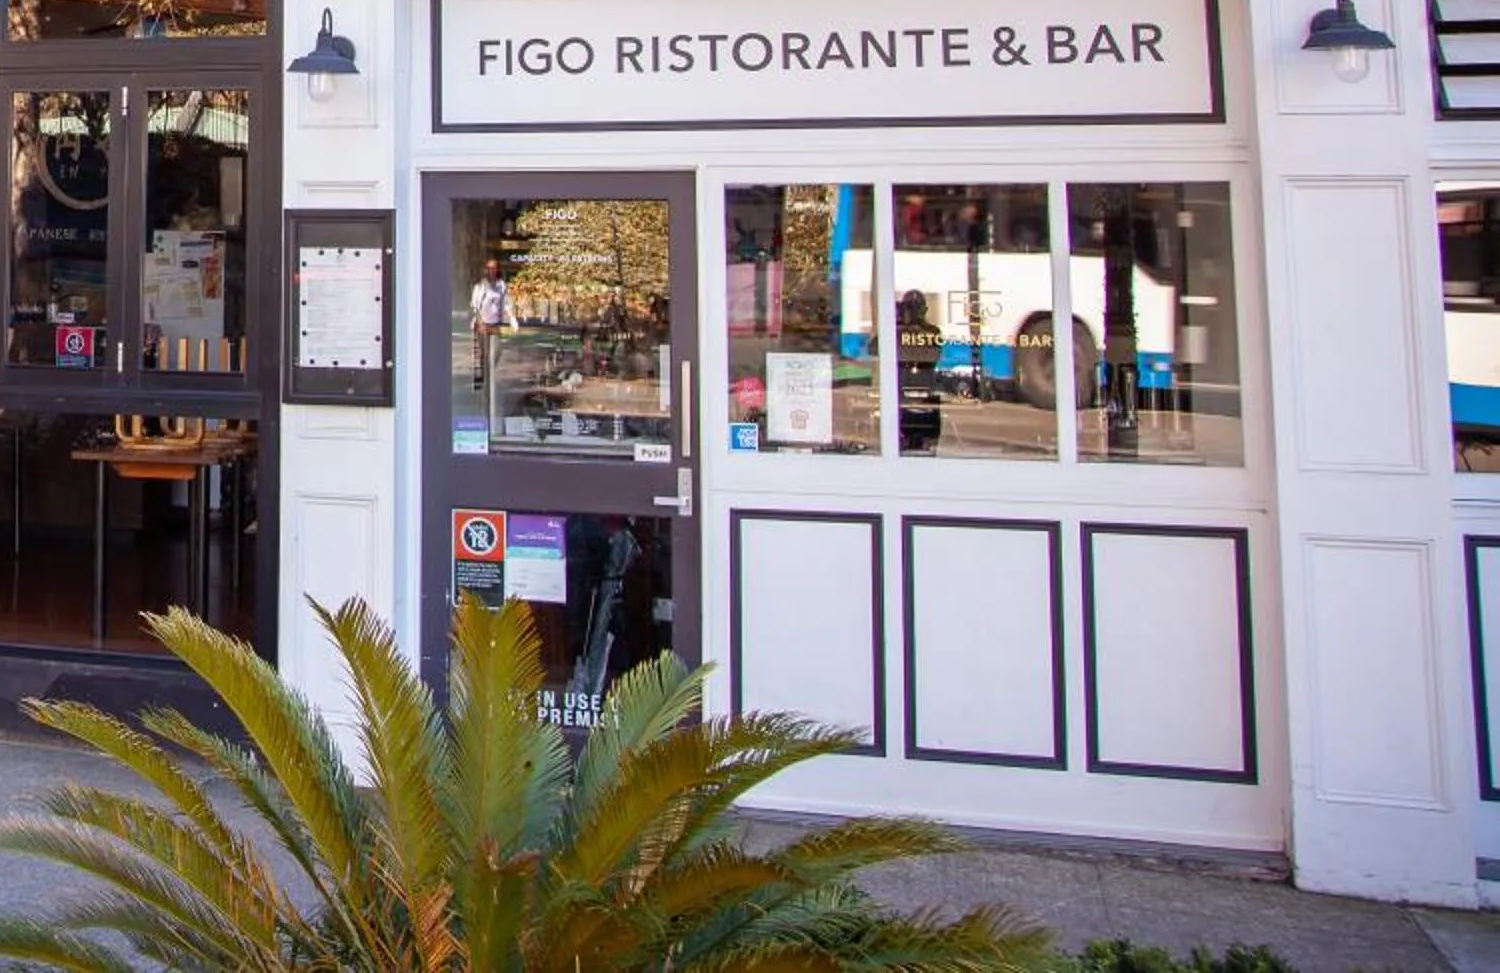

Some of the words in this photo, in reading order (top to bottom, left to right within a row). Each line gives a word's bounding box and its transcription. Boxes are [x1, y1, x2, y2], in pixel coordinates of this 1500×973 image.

[479, 37, 595, 76] FIGO
[616, 28, 971, 73] RISTORANTE
[992, 26, 1031, 66] &
[1046, 23, 1165, 64] BAR
[545, 209, 578, 220] FIGO
[1019, 334, 1053, 348] BAR
[641, 448, 668, 459] PUSH
[537, 690, 556, 707] IN
[563, 692, 602, 712] USE
